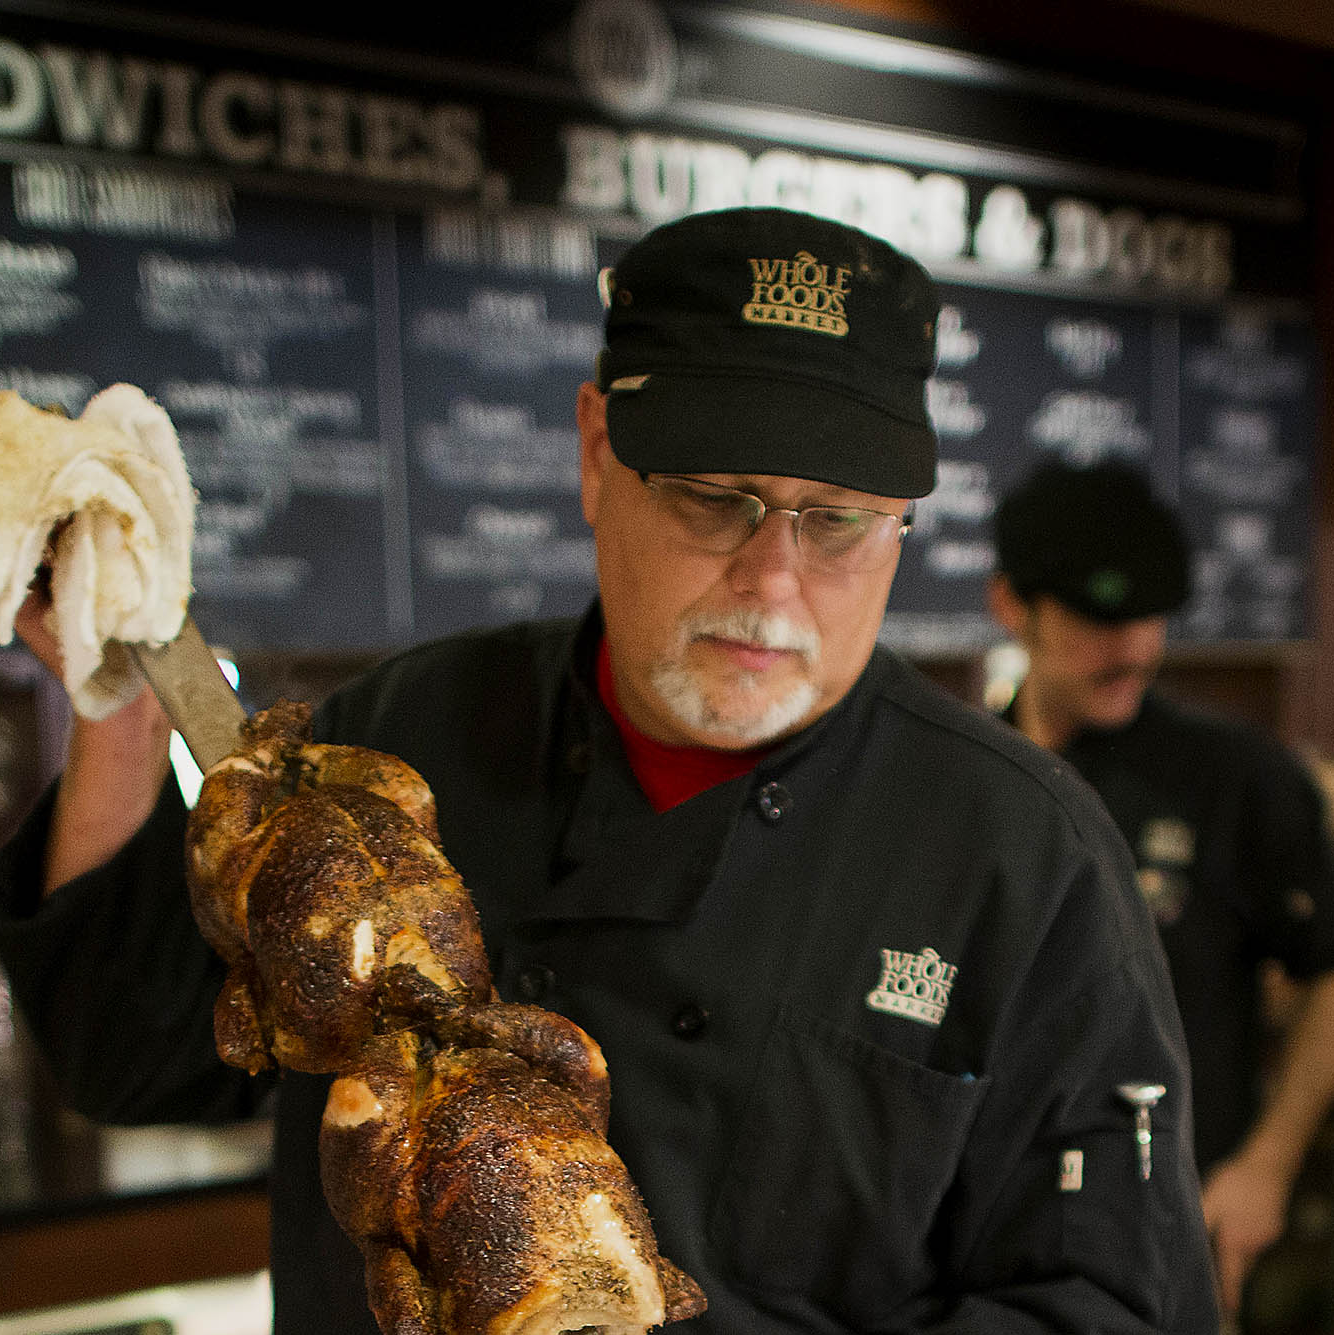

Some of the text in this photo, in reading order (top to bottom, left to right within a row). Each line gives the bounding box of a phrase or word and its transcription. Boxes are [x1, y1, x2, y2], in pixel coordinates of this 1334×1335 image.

[974, 183, 1043, 274] &
[747, 258, 851, 294] WHOLE
[750, 281, 846, 318] FOODS
[881, 949, 958, 987] WHOLE
[877, 970, 949, 1007] FOODS
